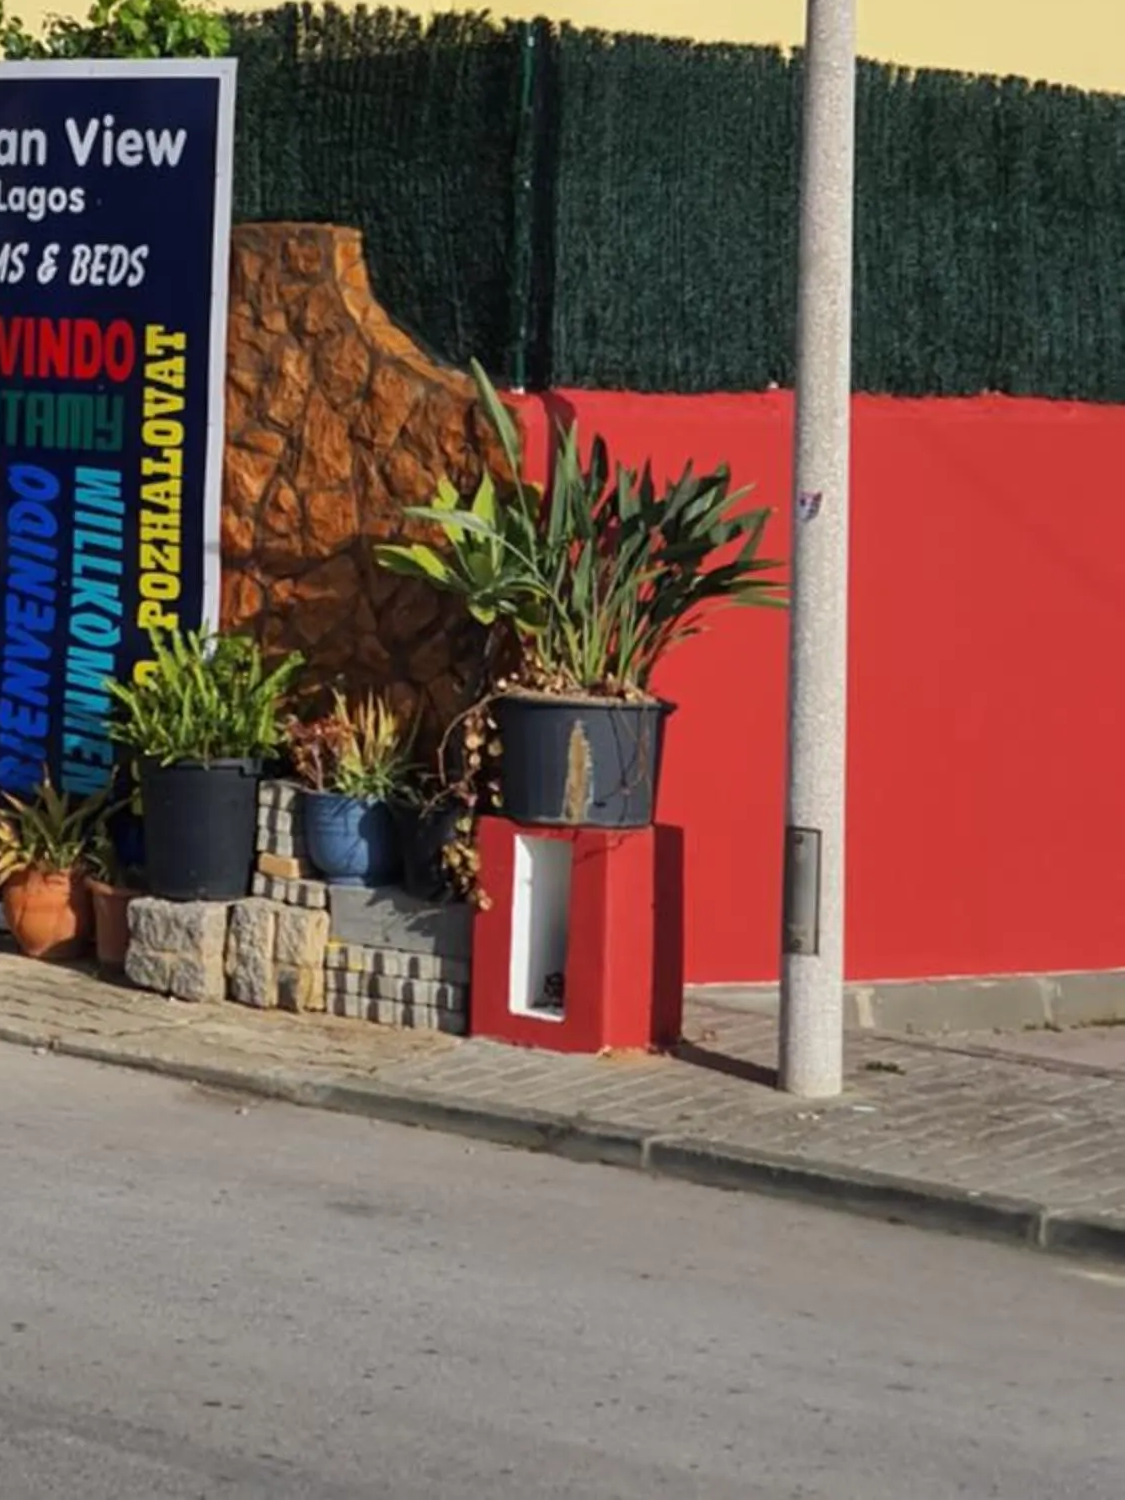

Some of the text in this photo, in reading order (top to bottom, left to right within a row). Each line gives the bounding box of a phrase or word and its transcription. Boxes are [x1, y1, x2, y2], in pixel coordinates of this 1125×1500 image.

[65, 113, 187, 168] View
[36, 242, 61, 286] &
[69, 243, 150, 288] BEDS
[61, 464, 126, 800] WILLKOMMEN
